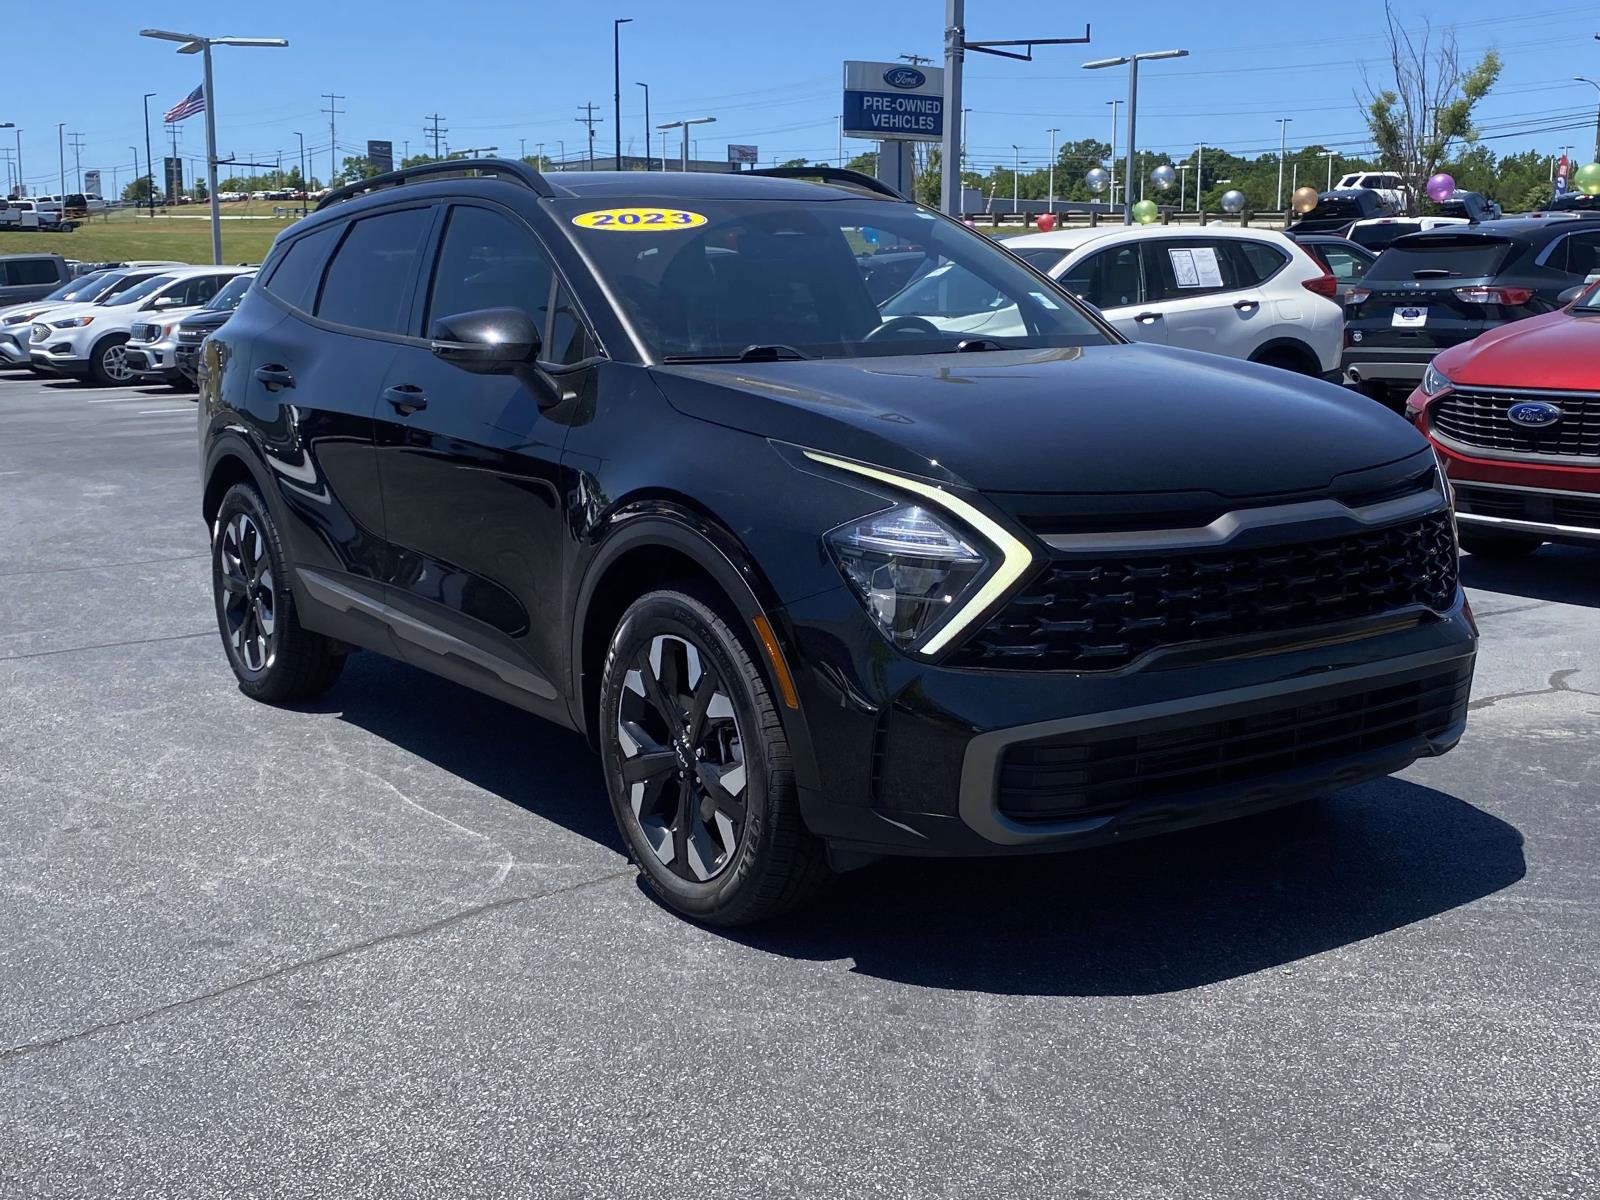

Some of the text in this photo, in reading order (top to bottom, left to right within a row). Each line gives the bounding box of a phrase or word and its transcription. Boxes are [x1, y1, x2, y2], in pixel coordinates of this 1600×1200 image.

[895, 71, 918, 85] Ford
[863, 97, 941, 114] PRE-OWNED
[871, 114, 935, 130] VEHICLES
[592, 213, 692, 225] 2023
